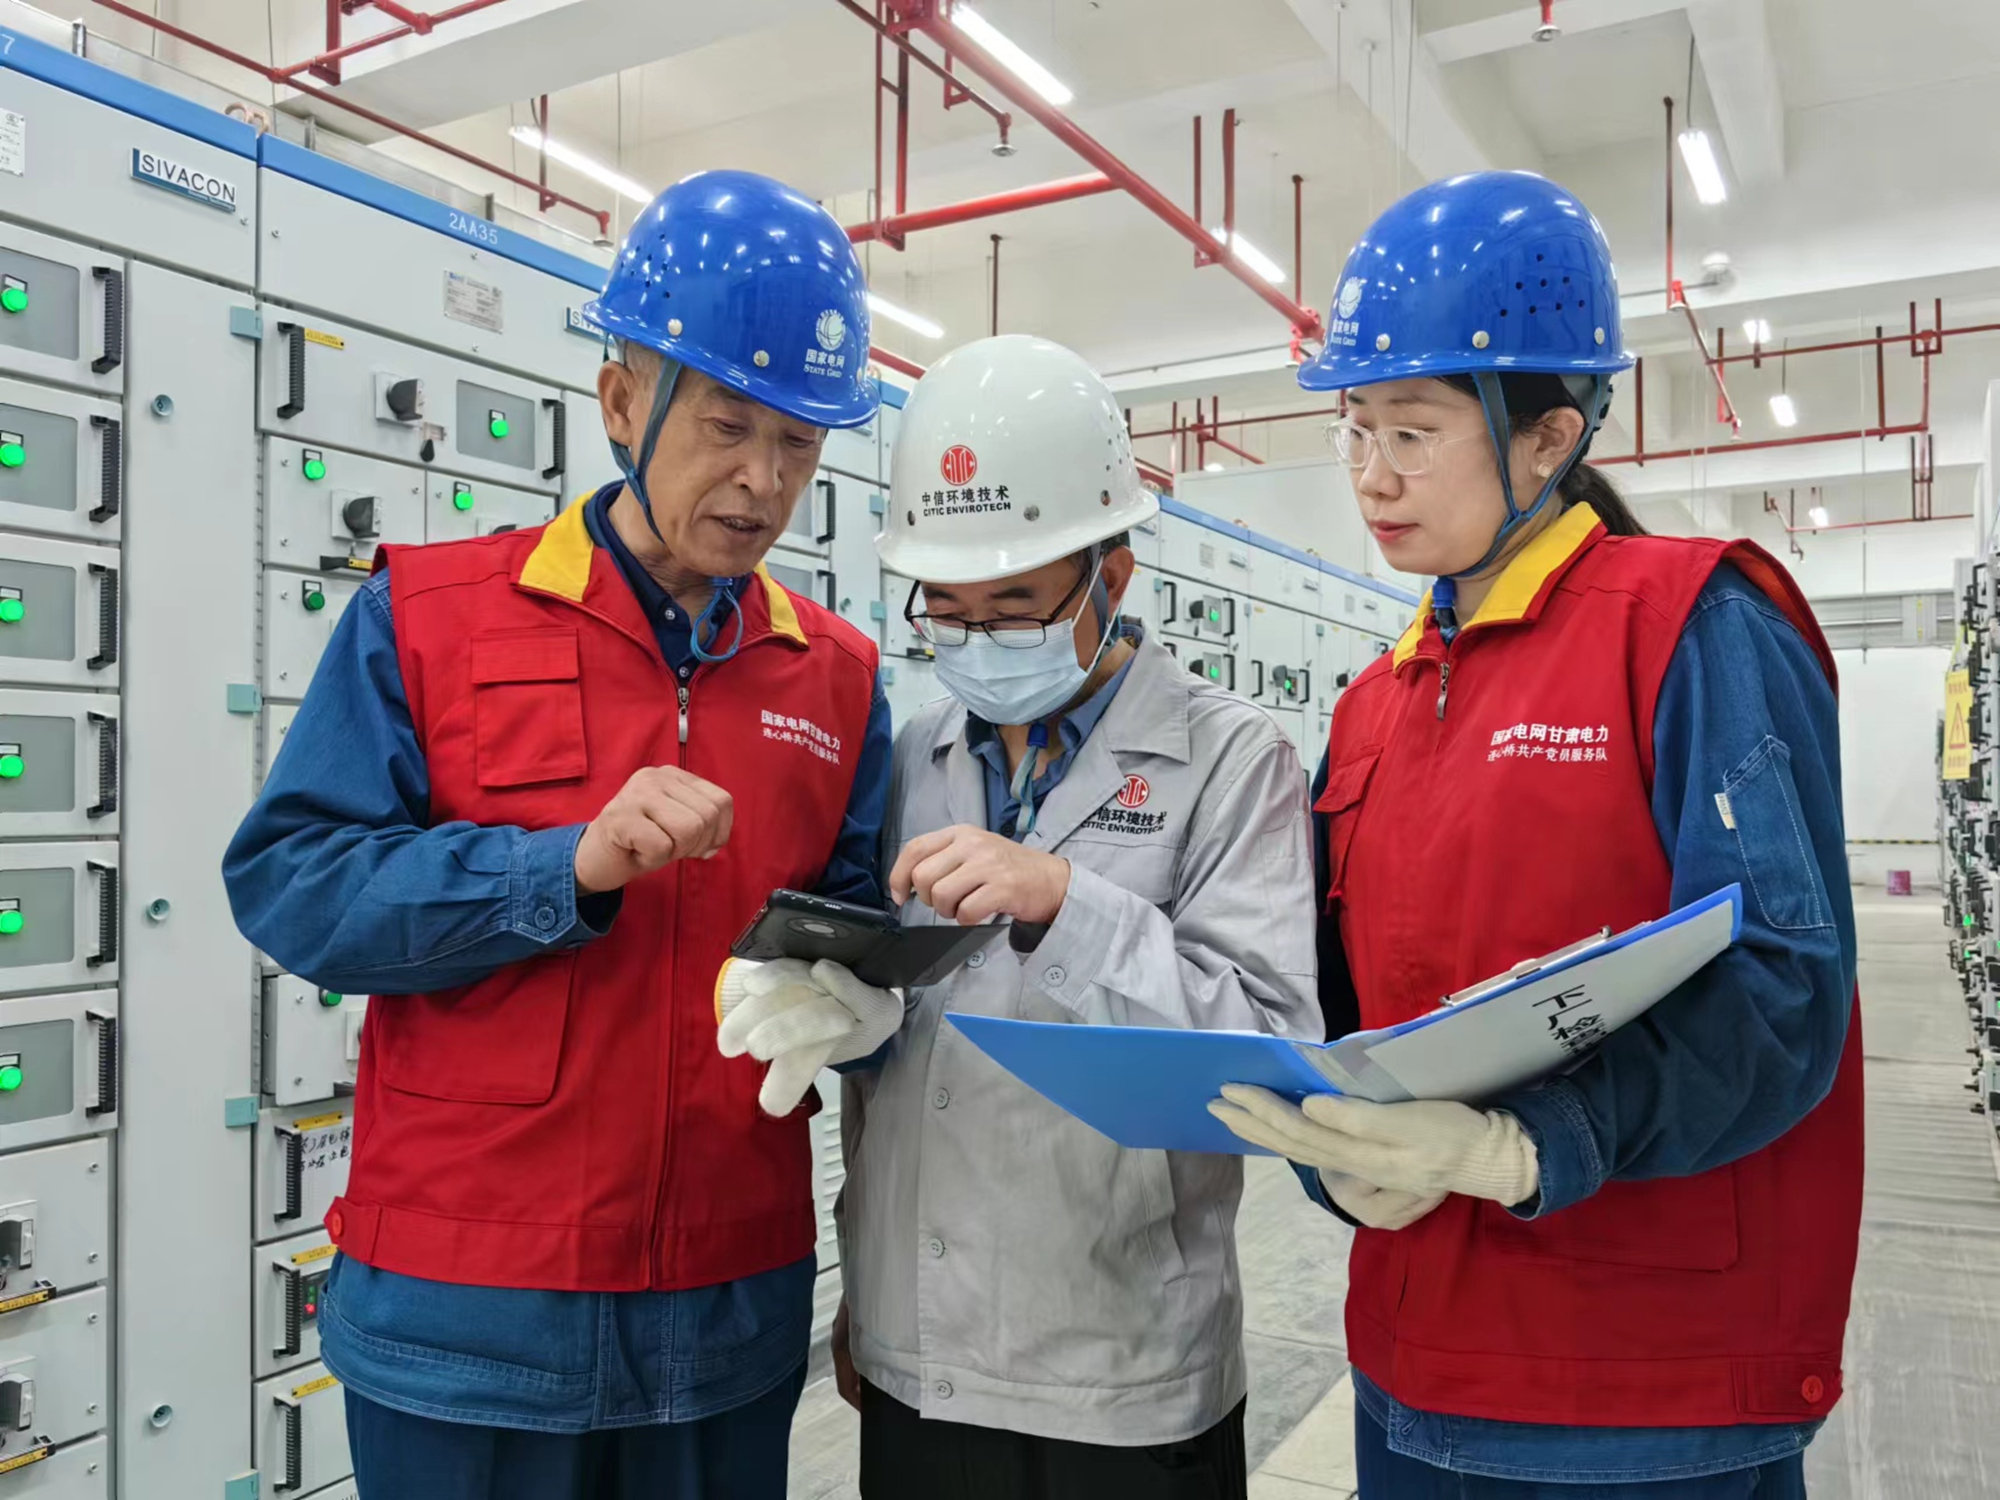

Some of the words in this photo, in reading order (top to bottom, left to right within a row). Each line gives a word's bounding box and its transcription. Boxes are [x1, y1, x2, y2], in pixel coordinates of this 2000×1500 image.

[141, 154, 235, 203] SIVACON
[448, 212, 499, 245] 2AA35
[805, 348, 845, 369] 国家电网
[921, 485, 1010, 507] 中信环境技术
[923, 507, 945, 517] CITIC
[946, 501, 1011, 515] ENVIROTECH
[1095, 806, 1168, 828] 信环境技术
